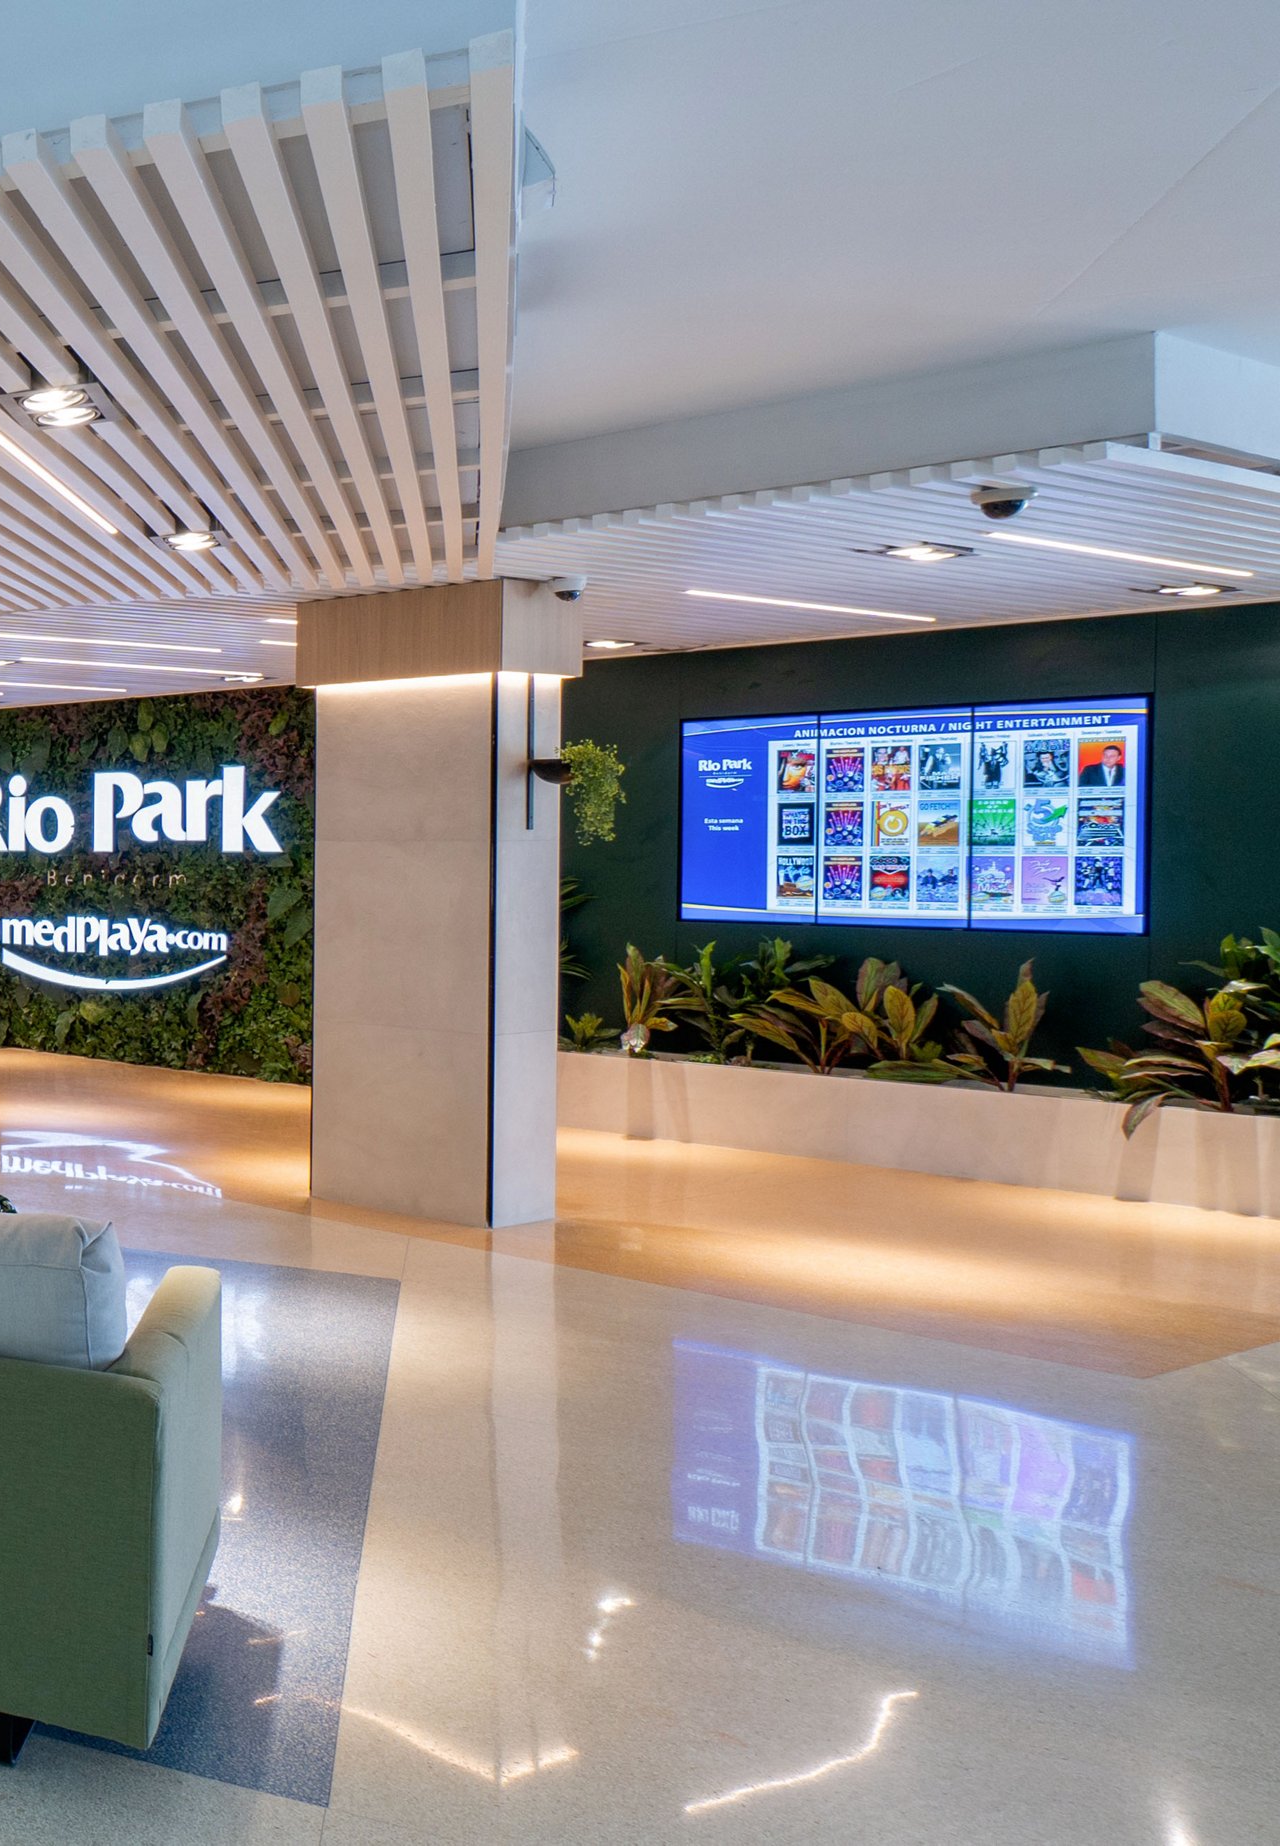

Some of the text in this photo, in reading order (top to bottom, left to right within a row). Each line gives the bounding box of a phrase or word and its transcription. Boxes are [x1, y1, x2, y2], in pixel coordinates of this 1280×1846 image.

[868, 723, 936, 735] NOCTURNA
[948, 720, 993, 731] NIGHT
[996, 715, 1111, 729] ENTERTAINMENT
[698, 758, 753, 772] Rio Park
[93, 765, 283, 853] Park
[785, 825, 806, 835] BOX
